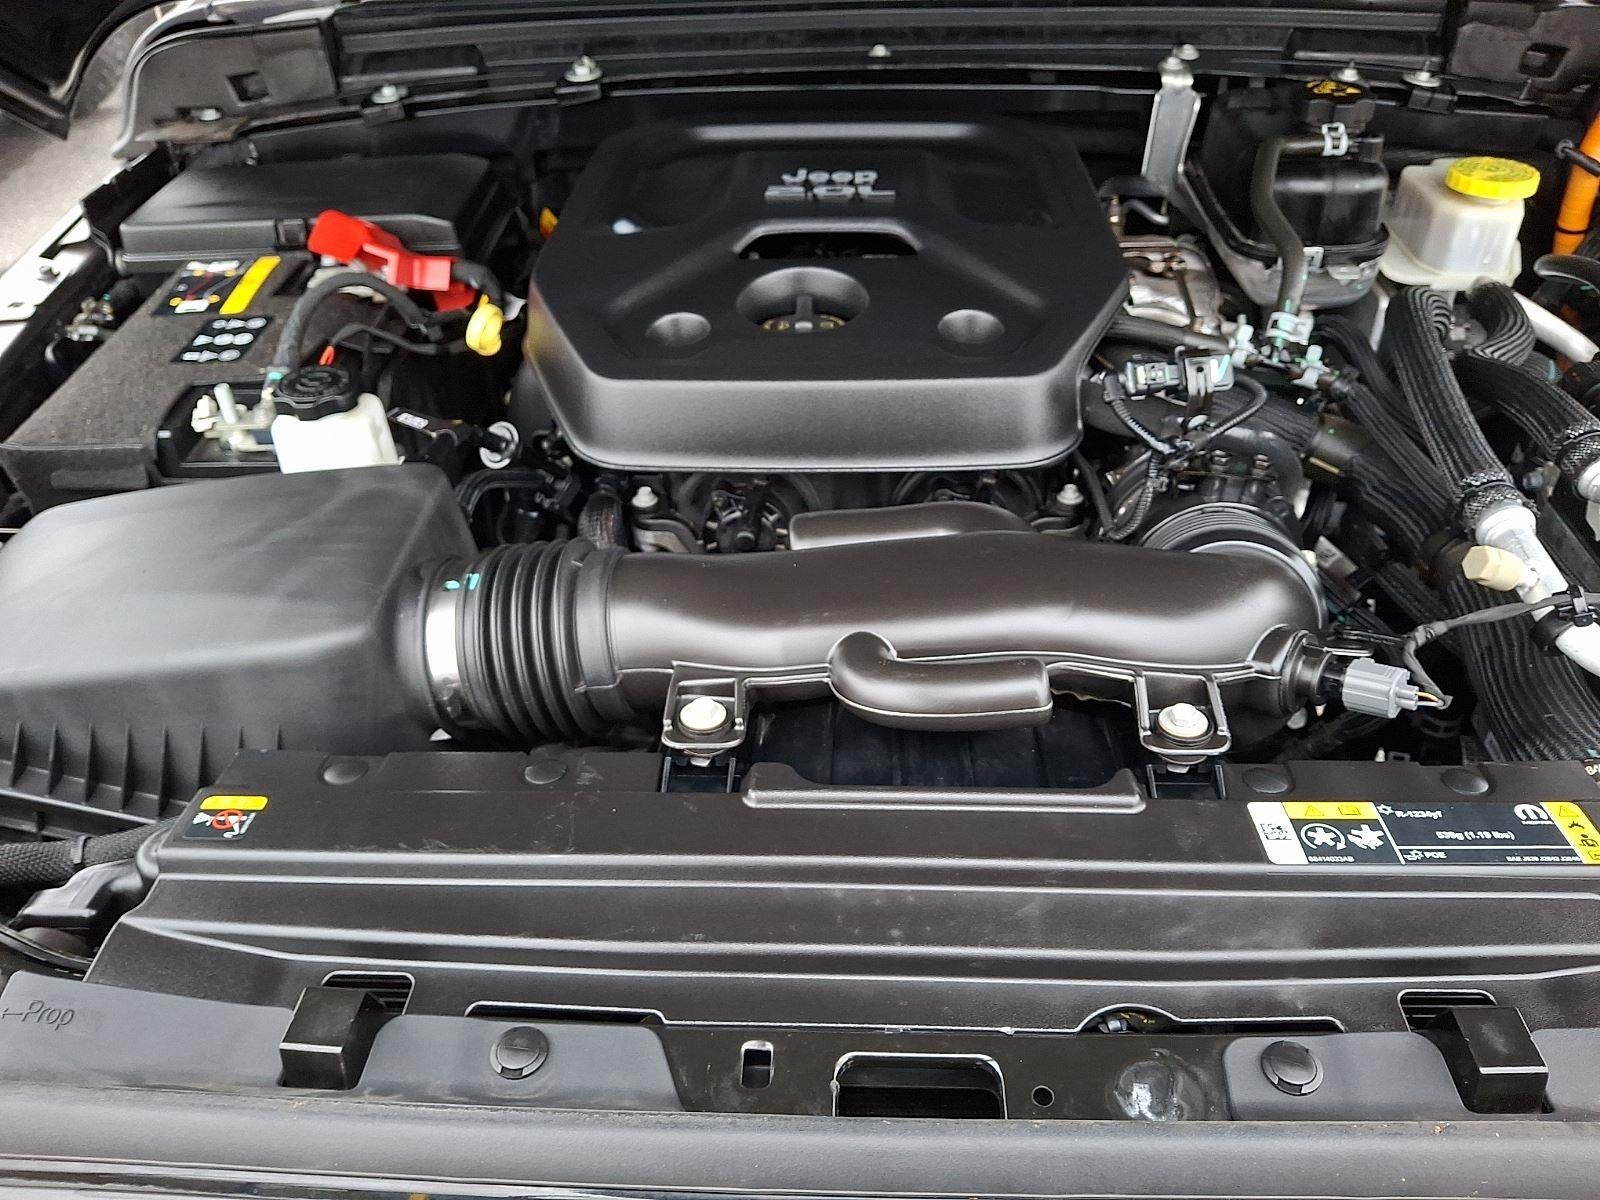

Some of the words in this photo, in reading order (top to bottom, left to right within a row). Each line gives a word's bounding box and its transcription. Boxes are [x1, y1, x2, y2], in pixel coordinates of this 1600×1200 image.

[781, 168, 877, 186] Jeep
[765, 185, 896, 201] 2.0L
[1424, 851, 1447, 859] POE
[22, 1000, 75, 1031] Prop
